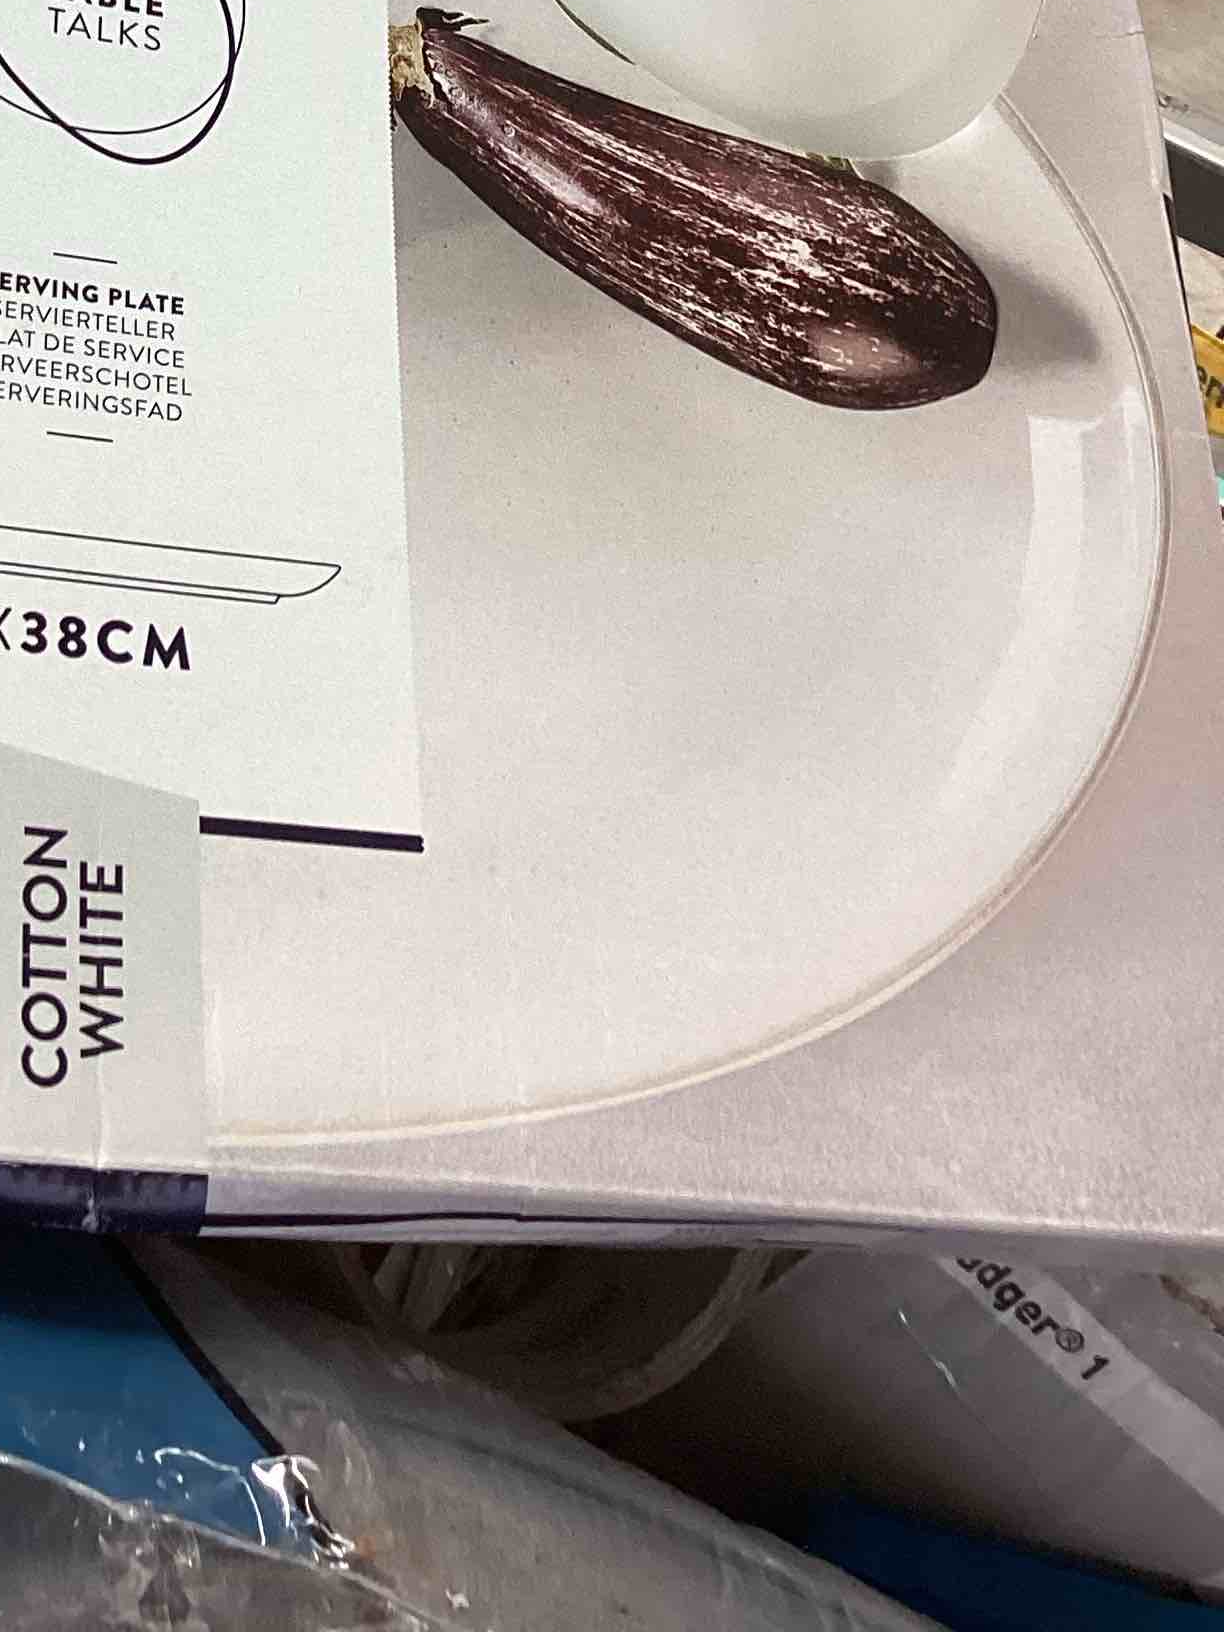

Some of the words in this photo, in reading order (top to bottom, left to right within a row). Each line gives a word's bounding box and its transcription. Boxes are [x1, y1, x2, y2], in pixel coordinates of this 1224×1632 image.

[48, 7, 161, 51] TALKS
[109, 287, 184, 315] PLATE
[44, 333, 75, 354] DE
[83, 338, 185, 369] SERVICE
[21, 826, 68, 1088] COTTON
[79, 861, 124, 1059] WHITE
[1081, 1354, 1111, 1380] 1
